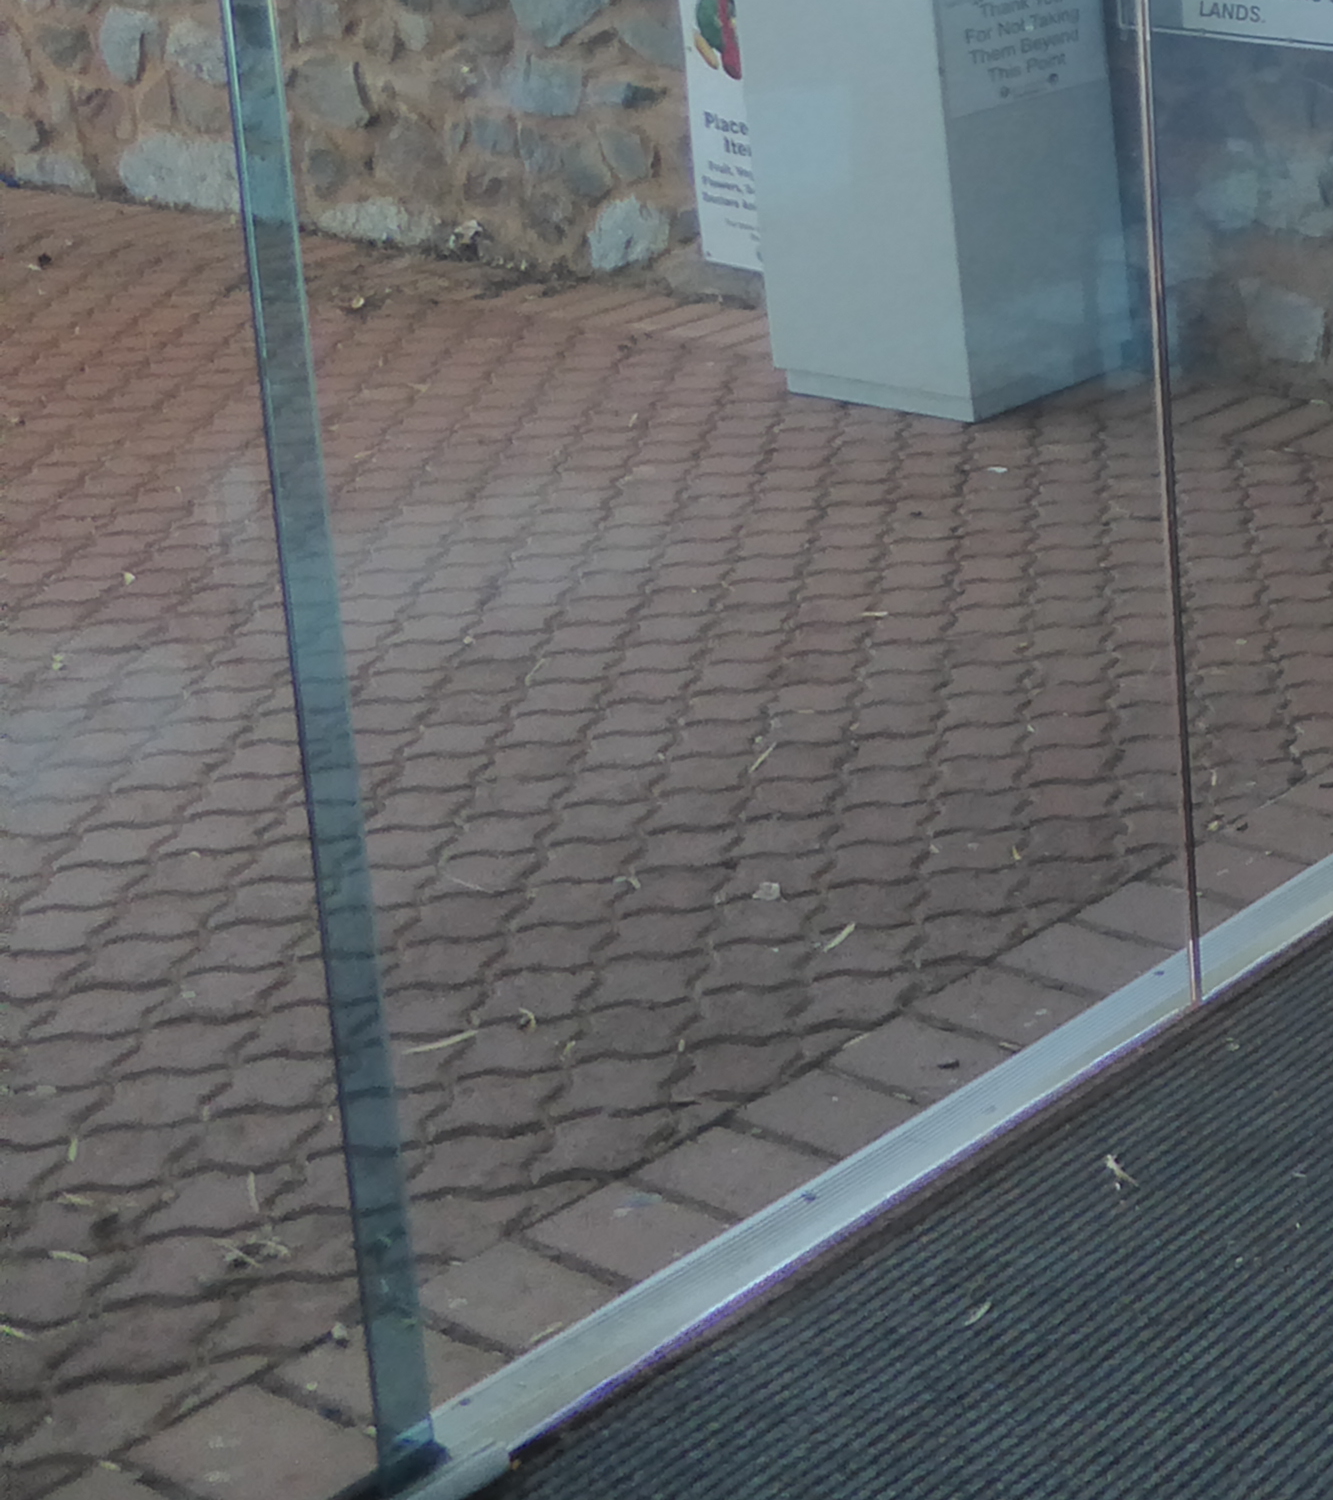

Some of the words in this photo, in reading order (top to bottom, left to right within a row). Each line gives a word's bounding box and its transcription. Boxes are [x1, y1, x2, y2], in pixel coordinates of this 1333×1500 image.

[964, 26, 993, 45] For
[997, 19, 1027, 36] Not
[1030, 7, 1080, 30] Taking
[1199, 1, 1267, 23] LANDS.
[968, 44, 1016, 65] Them
[1020, 28, 1080, 54] Beyond
[988, 64, 1022, 82] This
[1026, 51, 1066, 73] Point
[703, 111, 749, 136] Place
[723, 136, 752, 157] Ite
